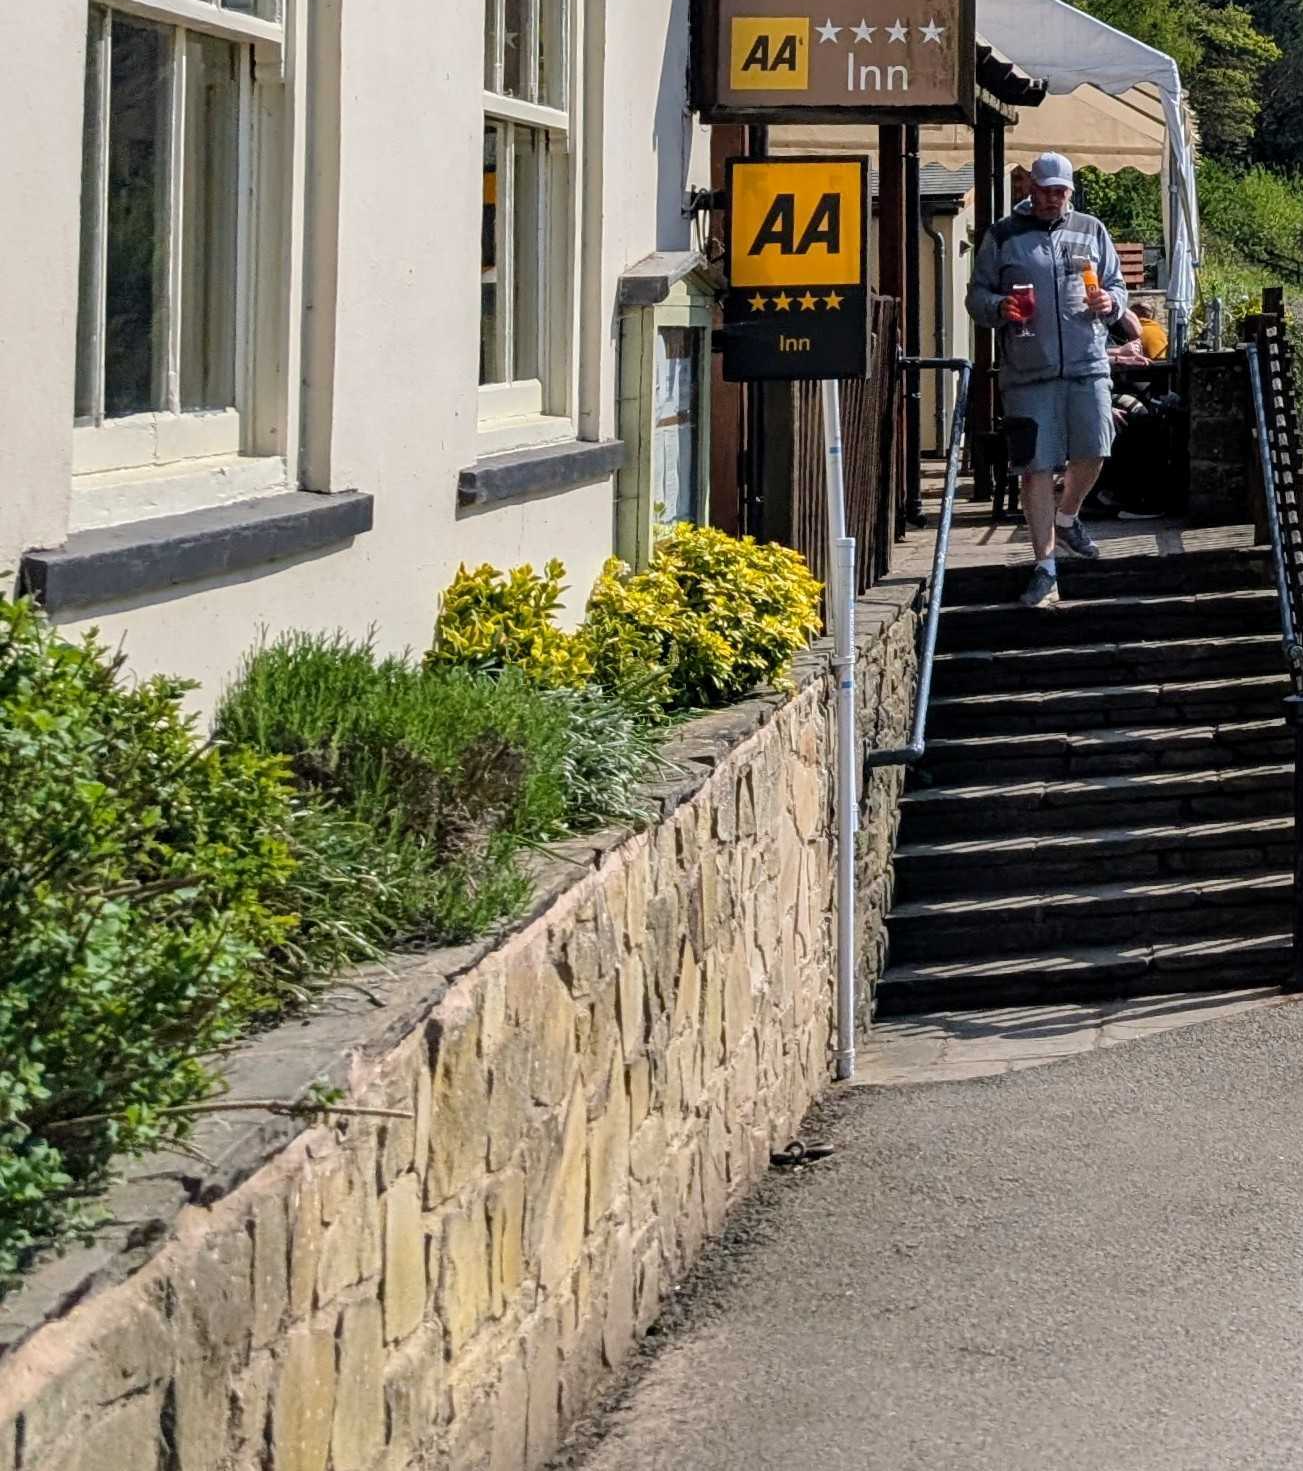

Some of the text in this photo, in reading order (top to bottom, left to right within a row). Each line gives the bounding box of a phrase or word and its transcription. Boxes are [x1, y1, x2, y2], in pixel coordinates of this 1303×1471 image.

[741, 34, 797, 72] AA
[847, 52, 909, 92] Inn
[747, 192, 841, 257] AA
[779, 334, 812, 353] Inn
